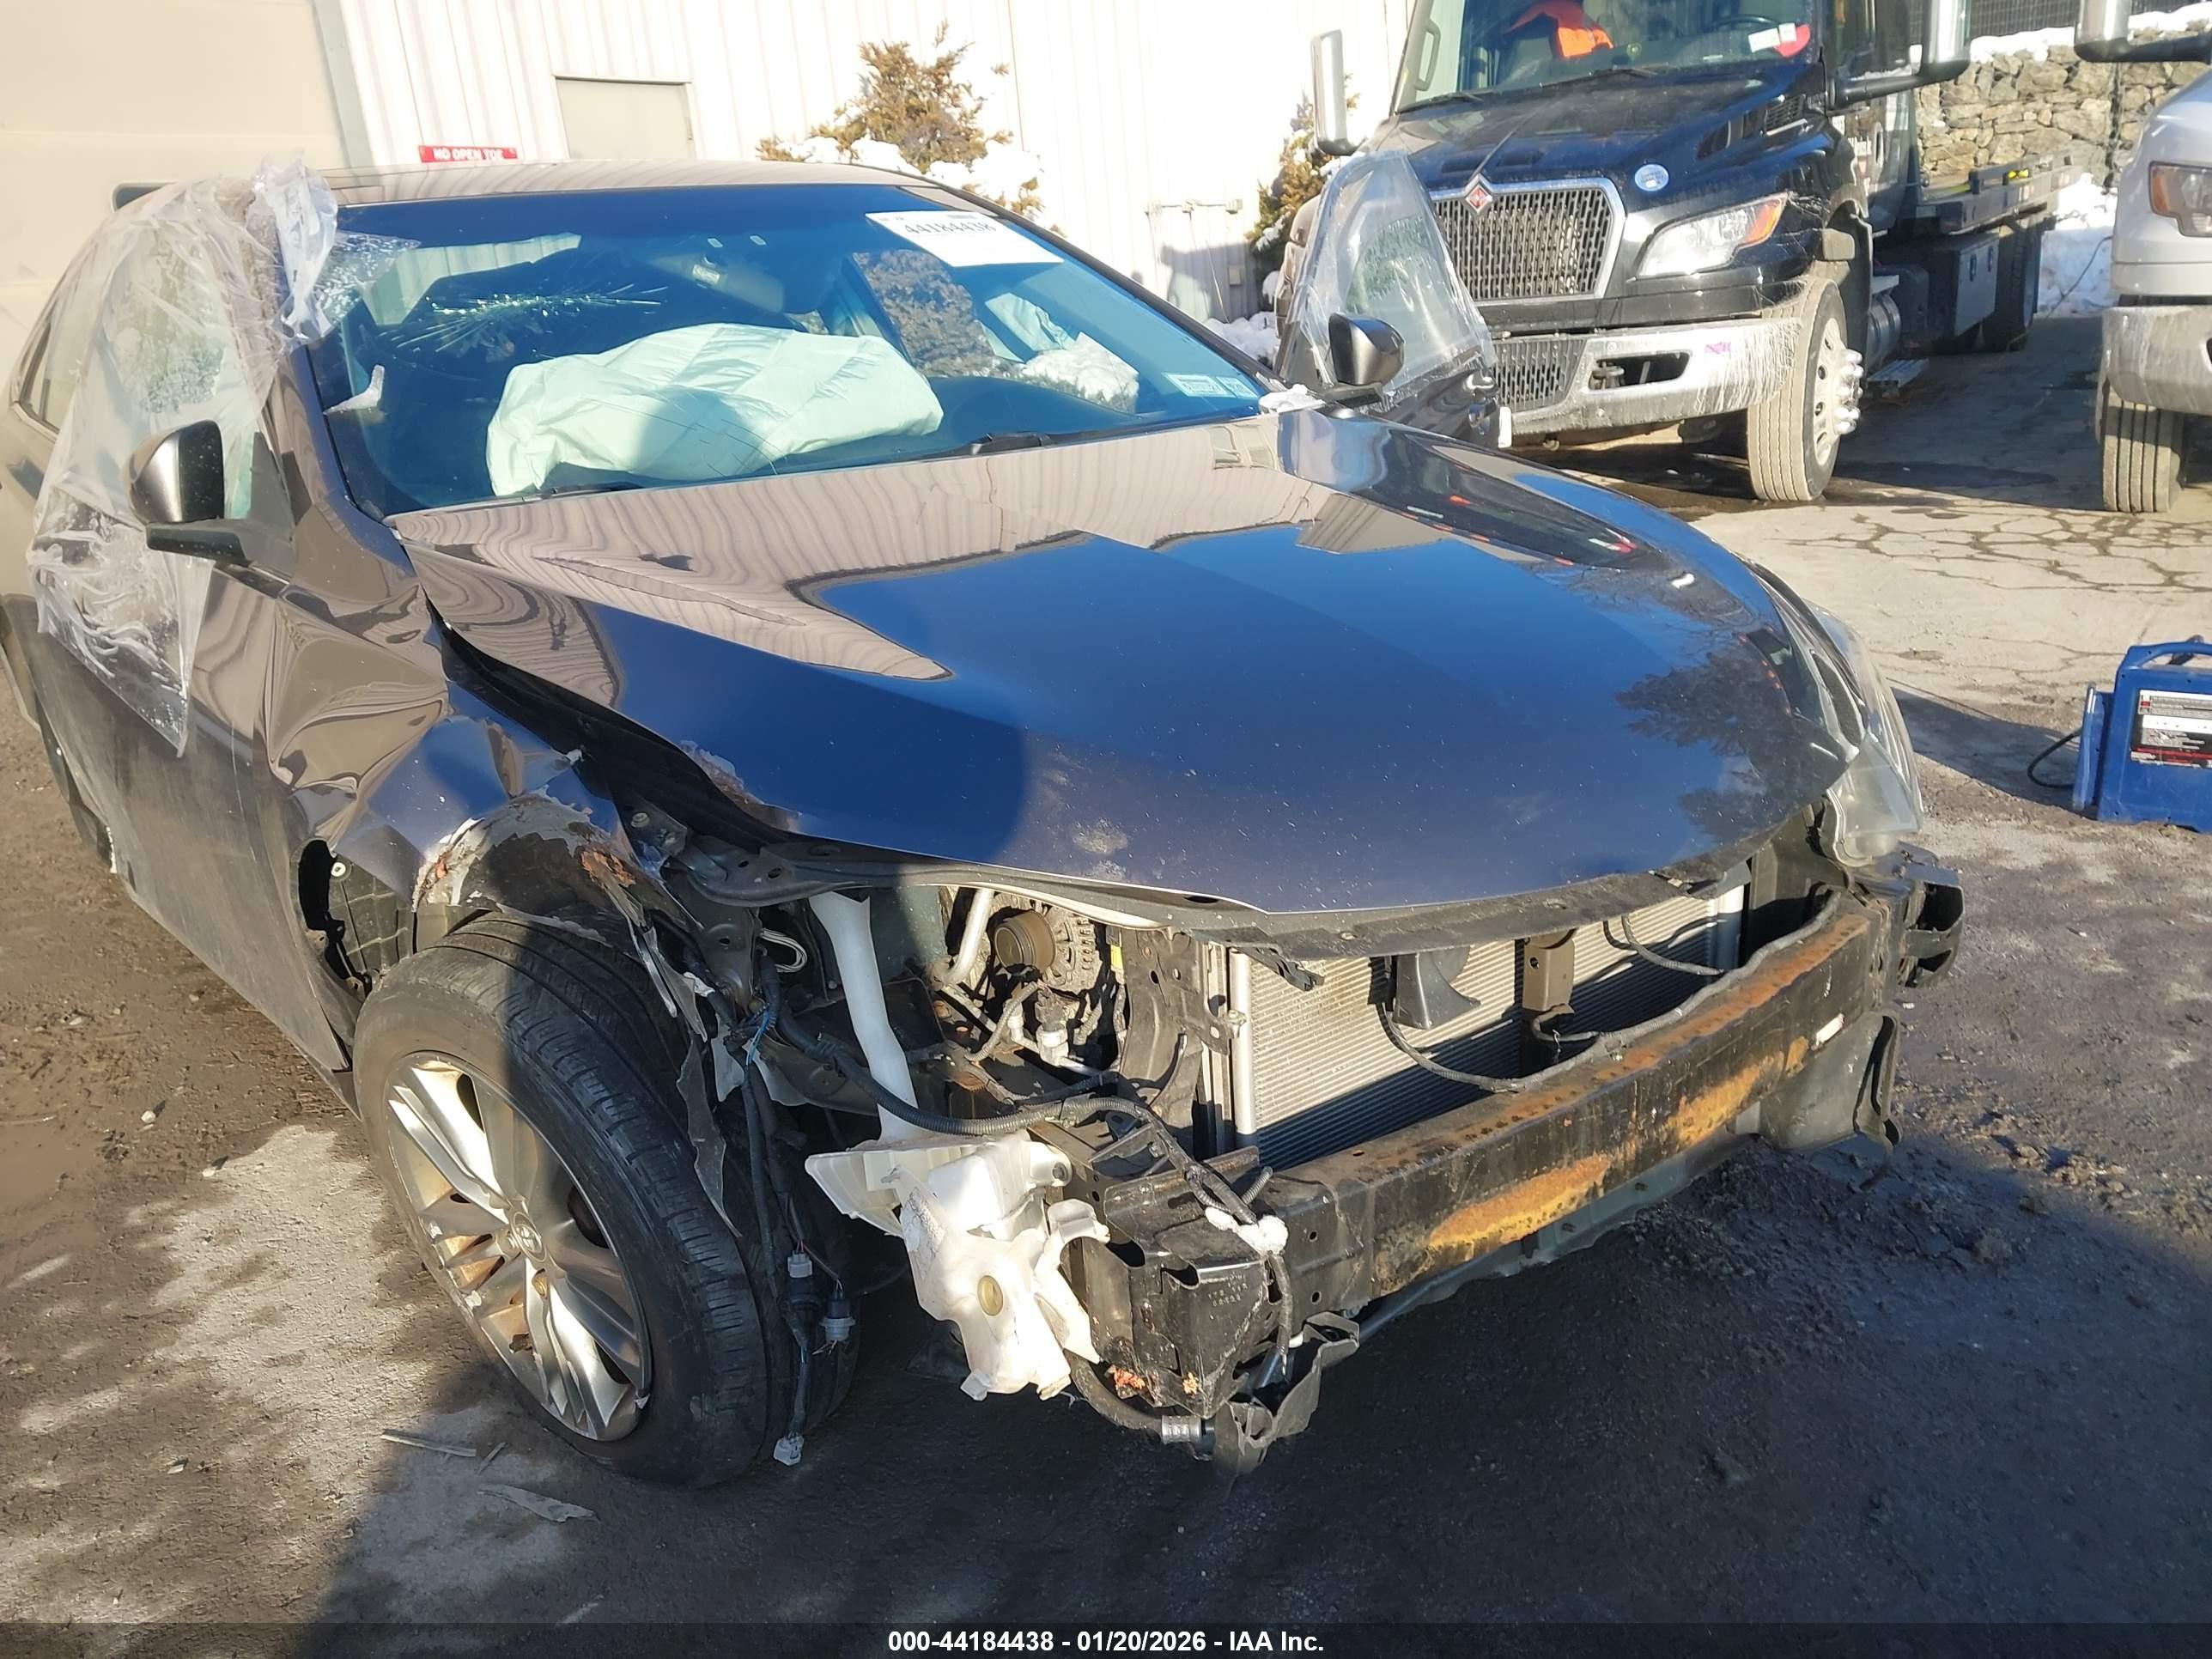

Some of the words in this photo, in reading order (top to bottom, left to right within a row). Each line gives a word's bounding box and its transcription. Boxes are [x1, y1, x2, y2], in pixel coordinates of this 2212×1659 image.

[433, 147, 451, 161] NO
[452, 148, 482, 161] OPEN
[903, 222, 997, 234] 44184438
